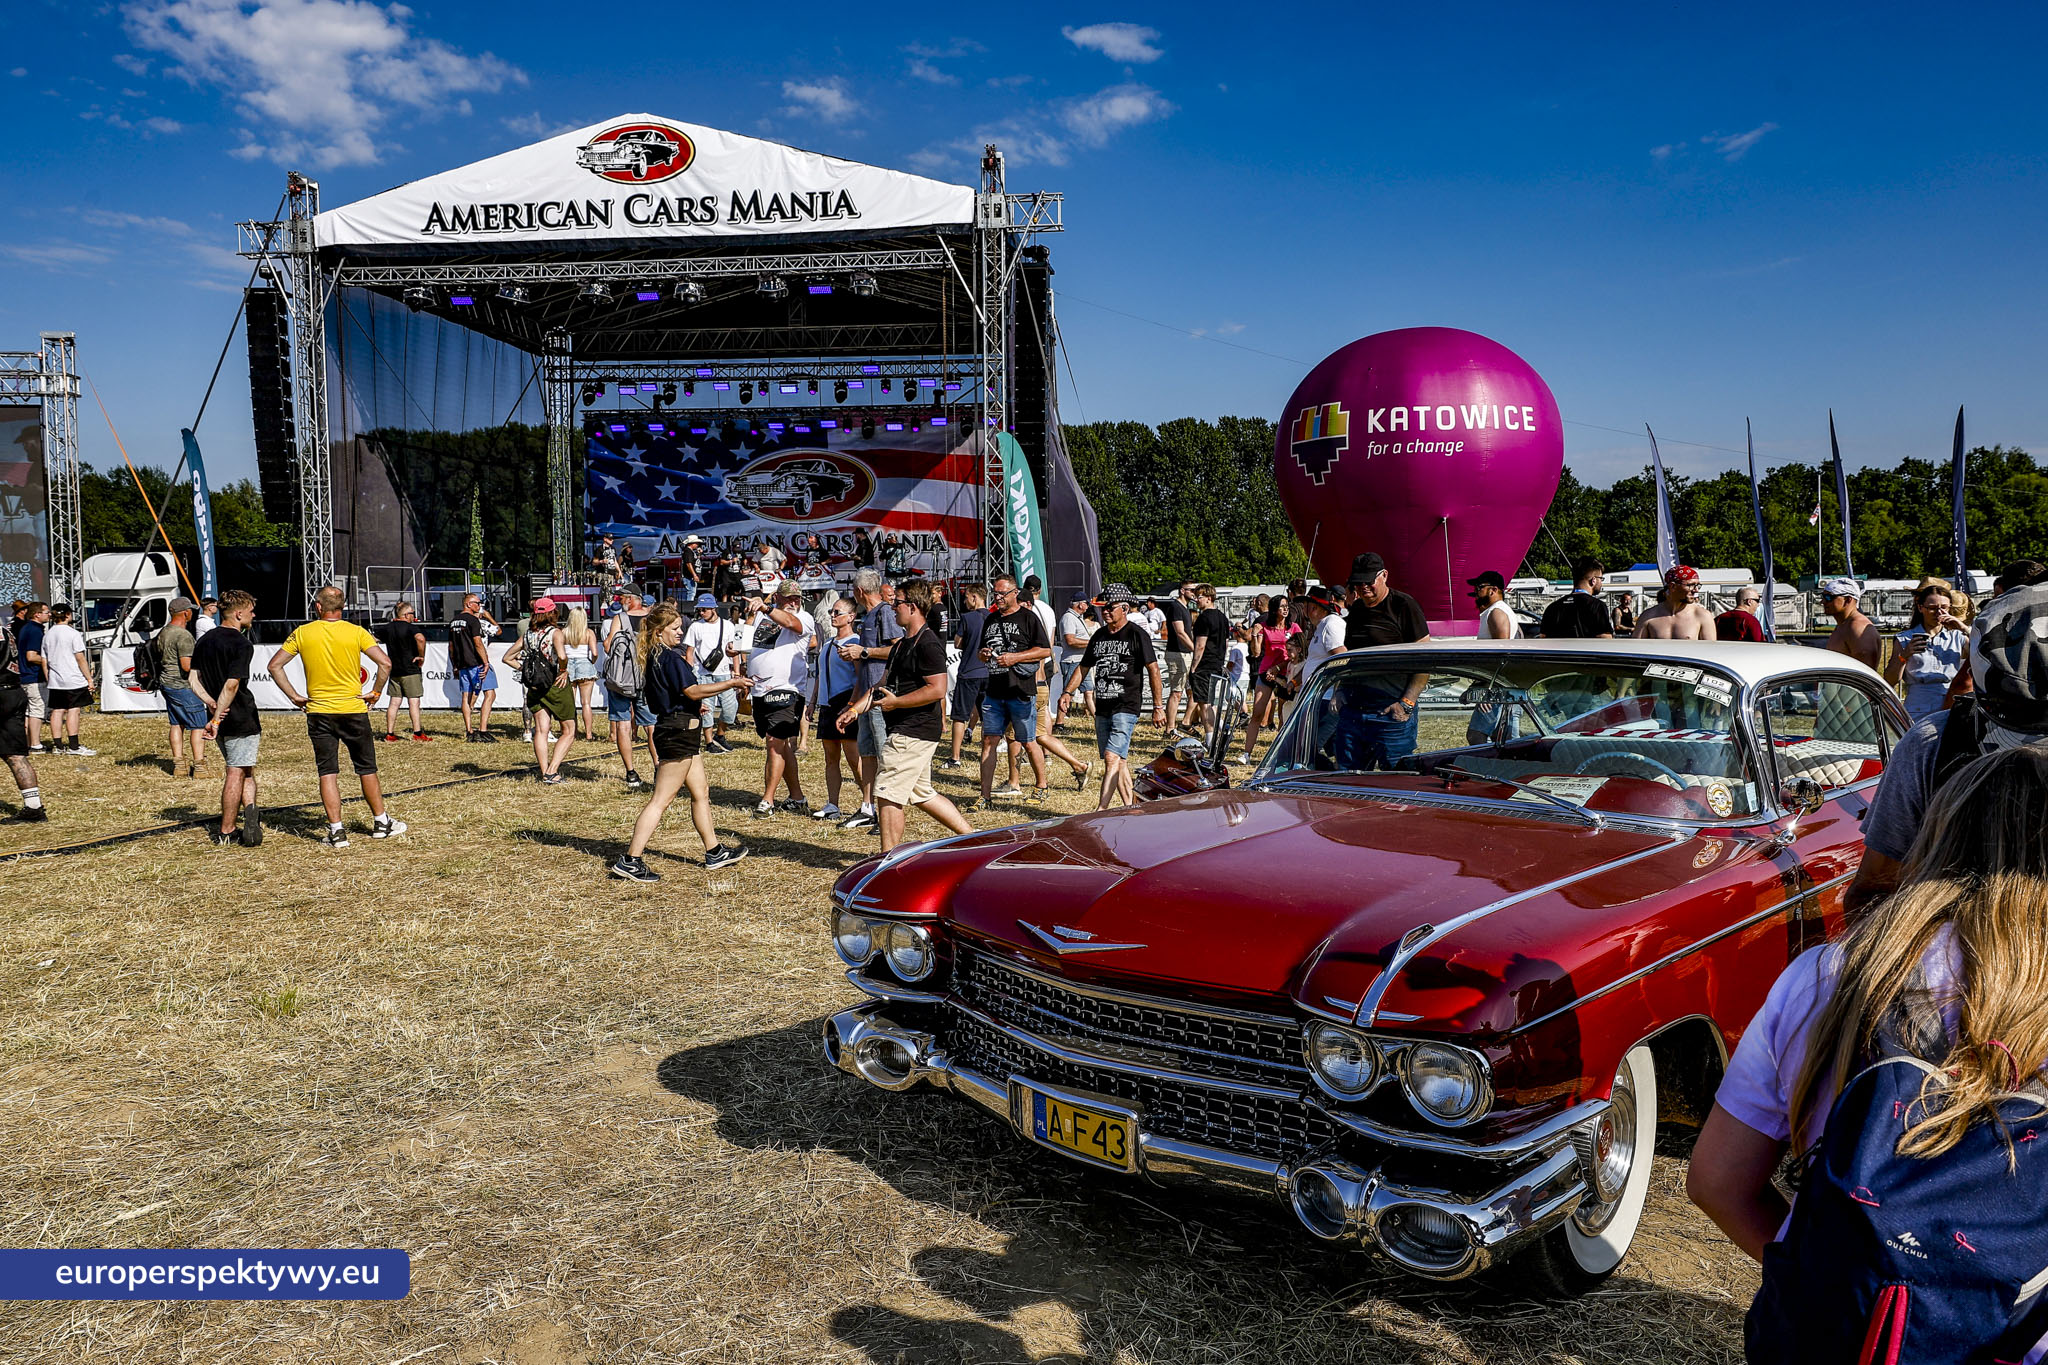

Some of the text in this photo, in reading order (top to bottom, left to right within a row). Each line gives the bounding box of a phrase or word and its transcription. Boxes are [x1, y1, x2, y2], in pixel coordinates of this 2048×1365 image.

[421, 188, 862, 235] AMERICAN CARS MANIA
[1367, 404, 1537, 434] KATOWICE
[1367, 438, 1464, 460] for a change
[1037, 1119, 1046, 1132] PL
